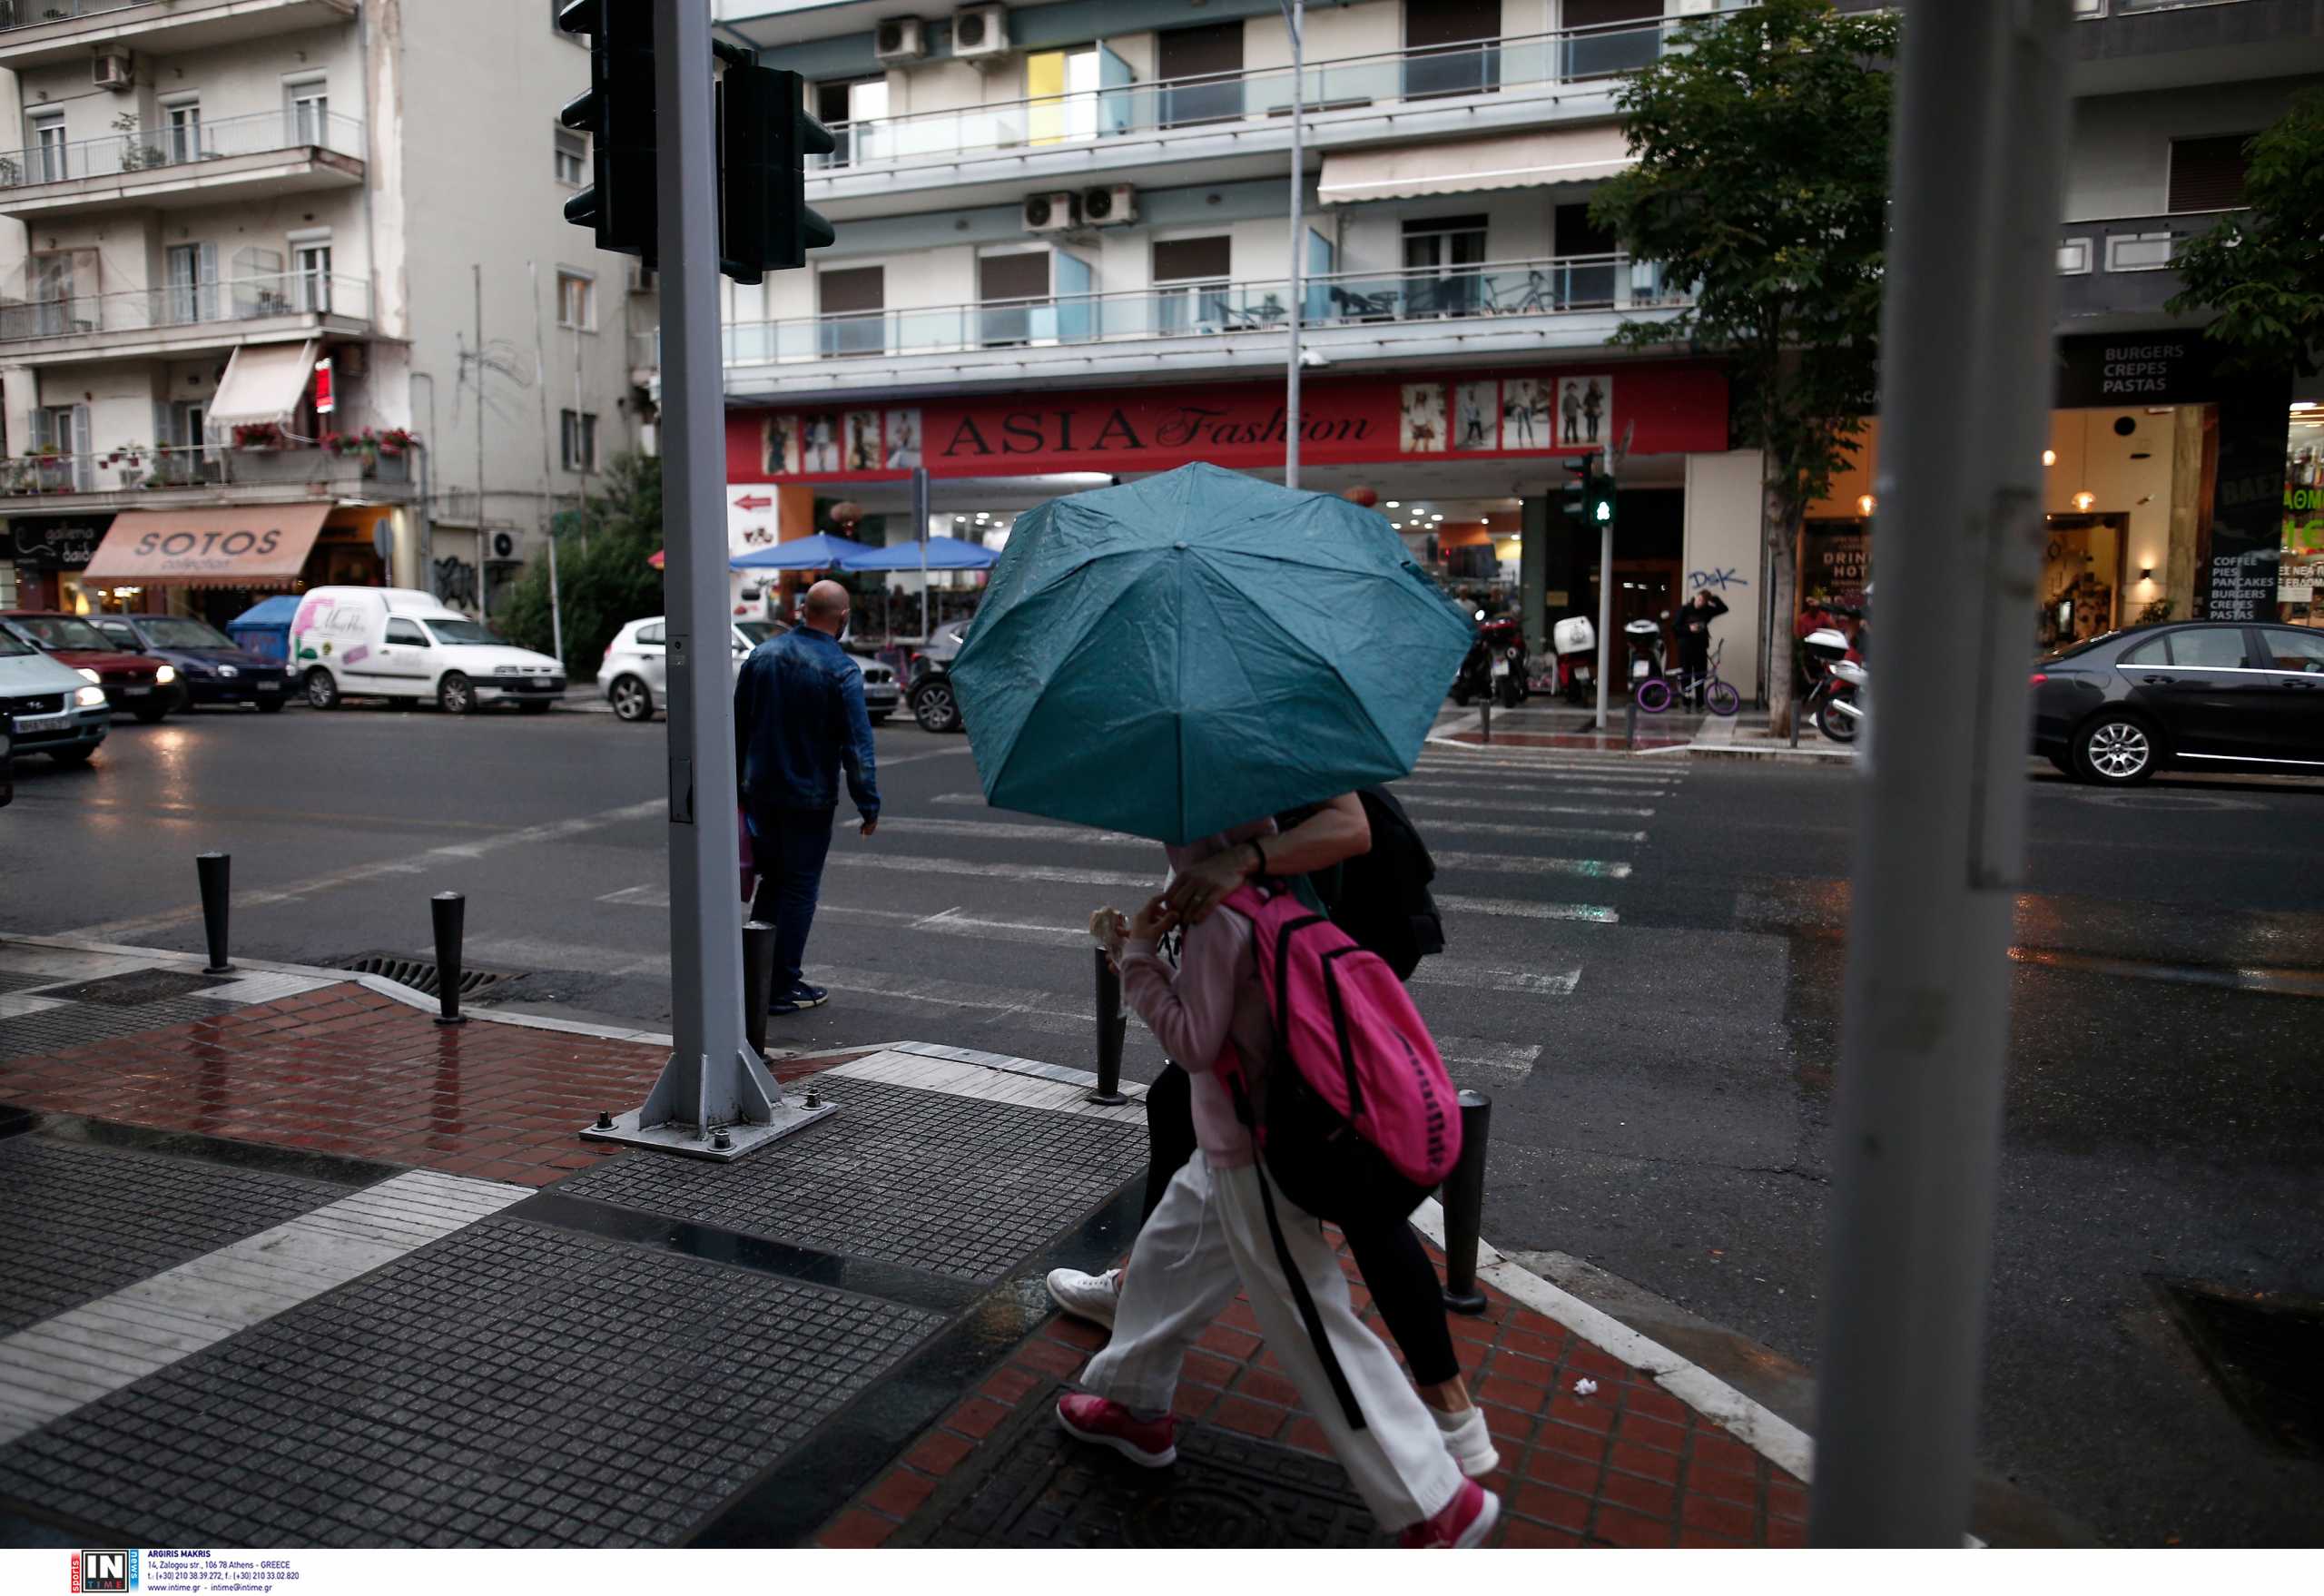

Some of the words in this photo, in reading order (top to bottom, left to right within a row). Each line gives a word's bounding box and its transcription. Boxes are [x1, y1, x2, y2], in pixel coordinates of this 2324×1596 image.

[2104, 344, 2185, 362] BURGERS
[2102, 362, 2167, 378] CREPES
[2102, 379, 2166, 394] PASTAS
[940, 408, 1147, 457] ASIA
[1157, 405, 1374, 448] Fashion
[133, 529, 281, 557] SOTOS
[1823, 552, 1873, 566] DRIN
[2213, 557, 2258, 566] COFFEE
[1832, 565, 1867, 578] HOT
[2212, 567, 2239, 577] PIES
[2212, 577, 2275, 588] PANCAKES
[2211, 589, 2267, 600] BURGERS
[2210, 600, 2254, 610] CREPES
[2210, 610, 2255, 620] PASTAS
